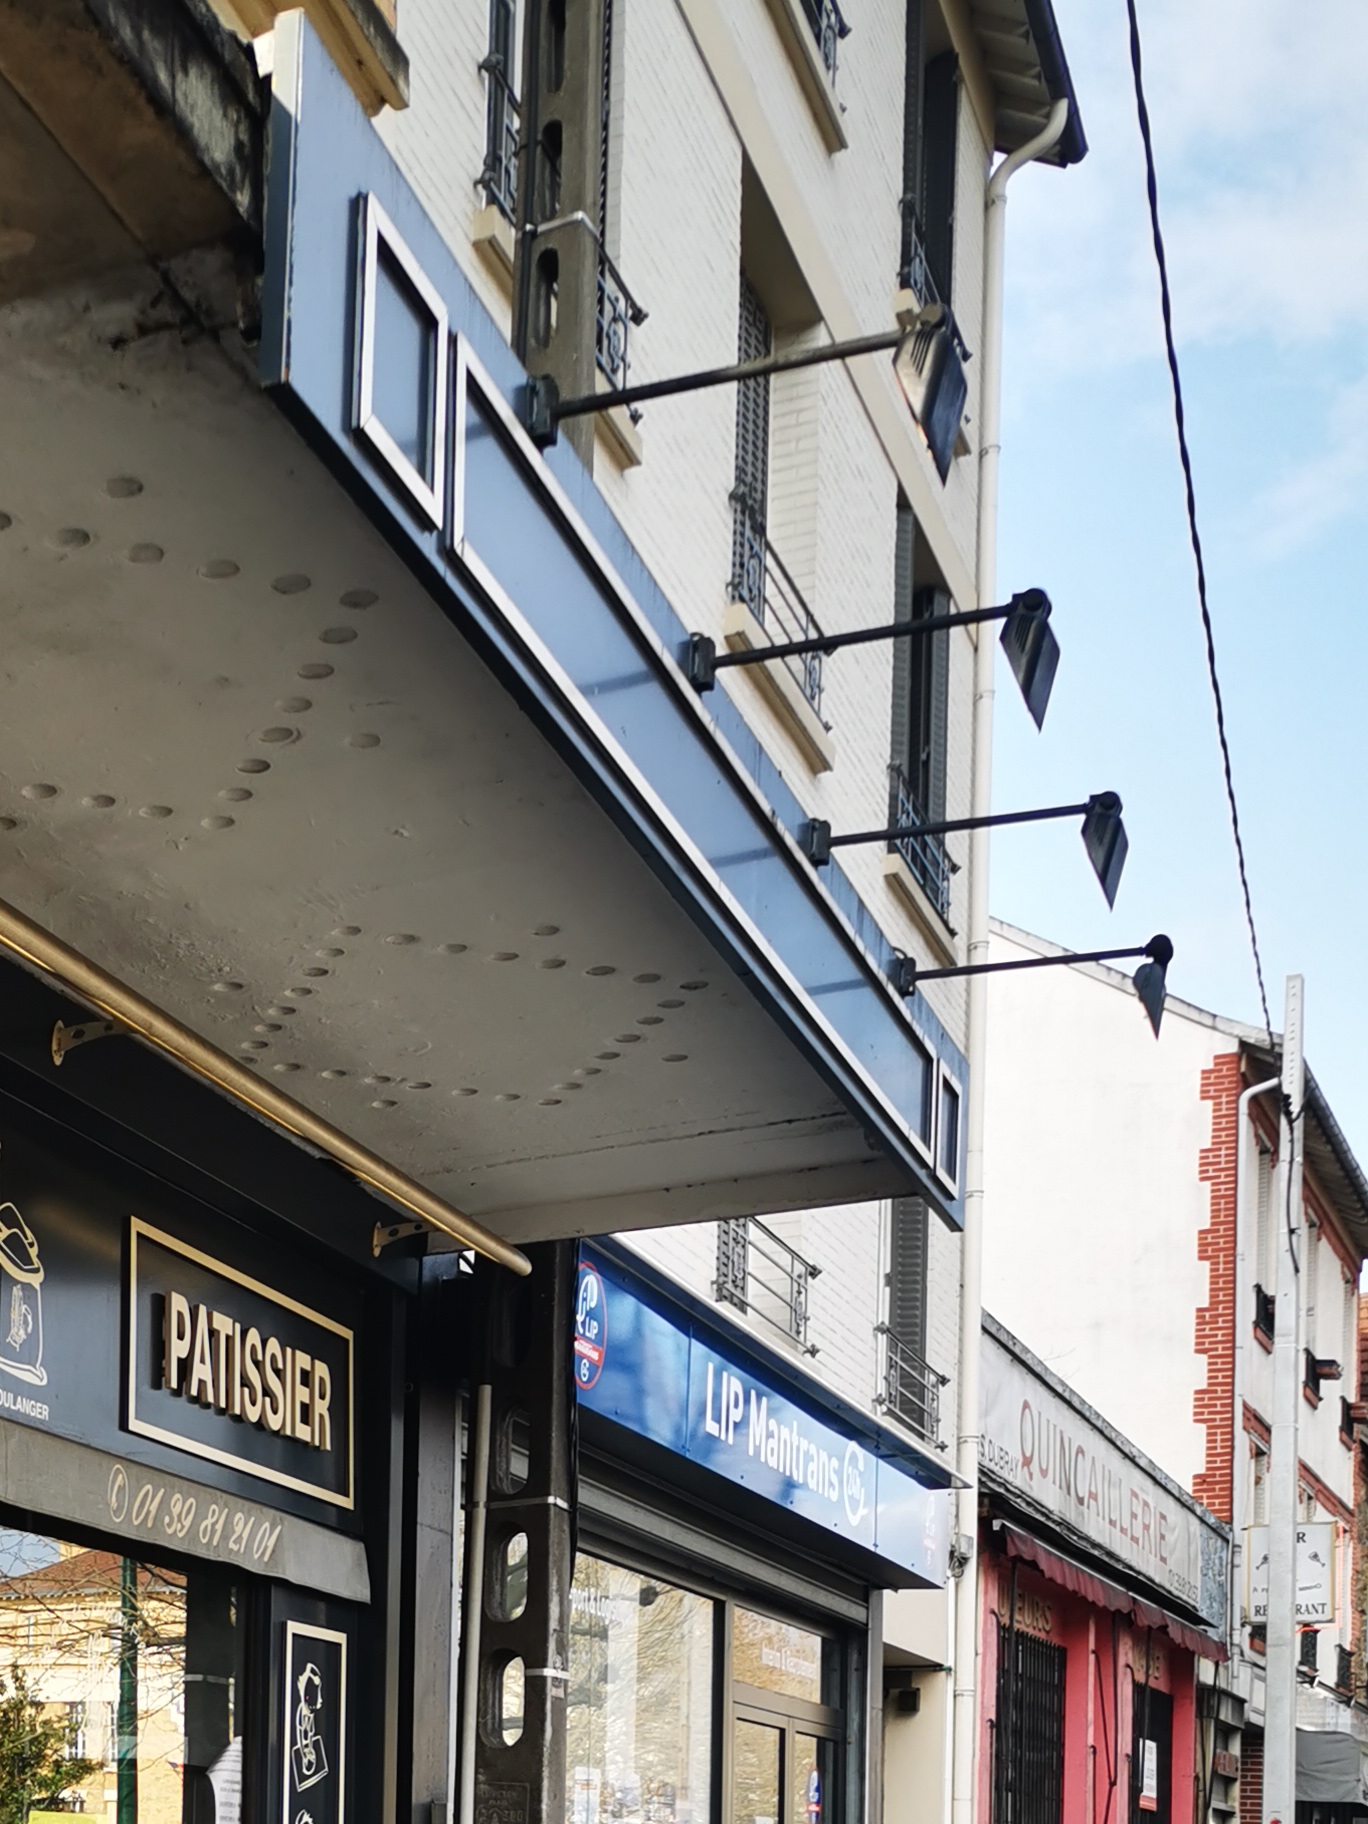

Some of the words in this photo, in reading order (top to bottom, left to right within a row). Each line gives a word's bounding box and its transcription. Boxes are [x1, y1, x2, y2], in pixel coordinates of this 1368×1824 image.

[585, 1316, 598, 1340] LIP
[163, 1289, 333, 1453] PATISSIER
[705, 1362, 744, 1445] LIP
[748, 1389, 839, 1502] Mantrans
[988, 1439, 1019, 1480] DUBRAY
[1020, 1399, 1169, 1566] QUINCAILLERIE
[132, 1484, 164, 1528] 01
[164, 1493, 196, 1538] 39
[199, 1504, 228, 1547] 81
[228, 1511, 255, 1554] 21
[253, 1521, 282, 1562] 01
[1254, 1603, 1327, 1616] RERANT
